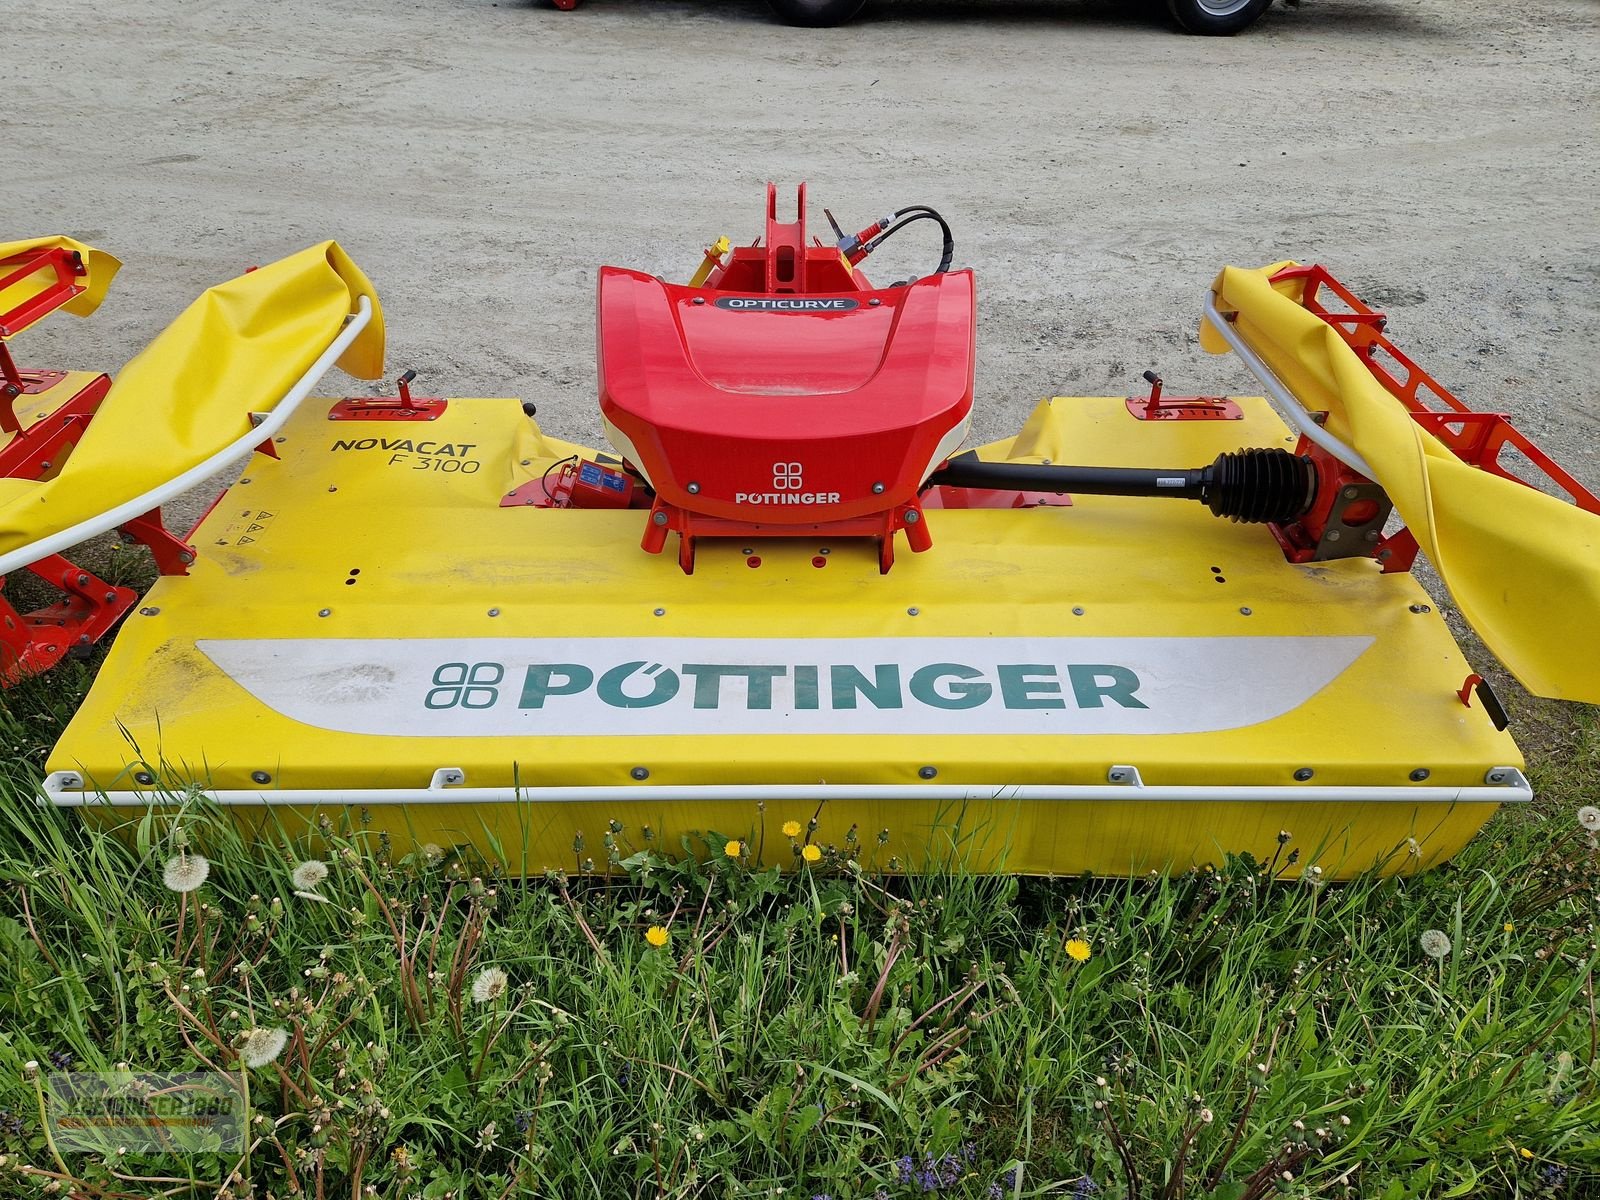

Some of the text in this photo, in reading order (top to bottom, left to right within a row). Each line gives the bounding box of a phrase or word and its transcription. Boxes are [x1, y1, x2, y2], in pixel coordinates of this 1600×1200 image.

[728, 299, 845, 309] OPTICURVE
[331, 438, 477, 457] NOVACAT
[388, 454, 480, 474] F 3100
[735, 492, 841, 505] PÖTTINGER
[518, 660, 1151, 710] PÖTTINGER
